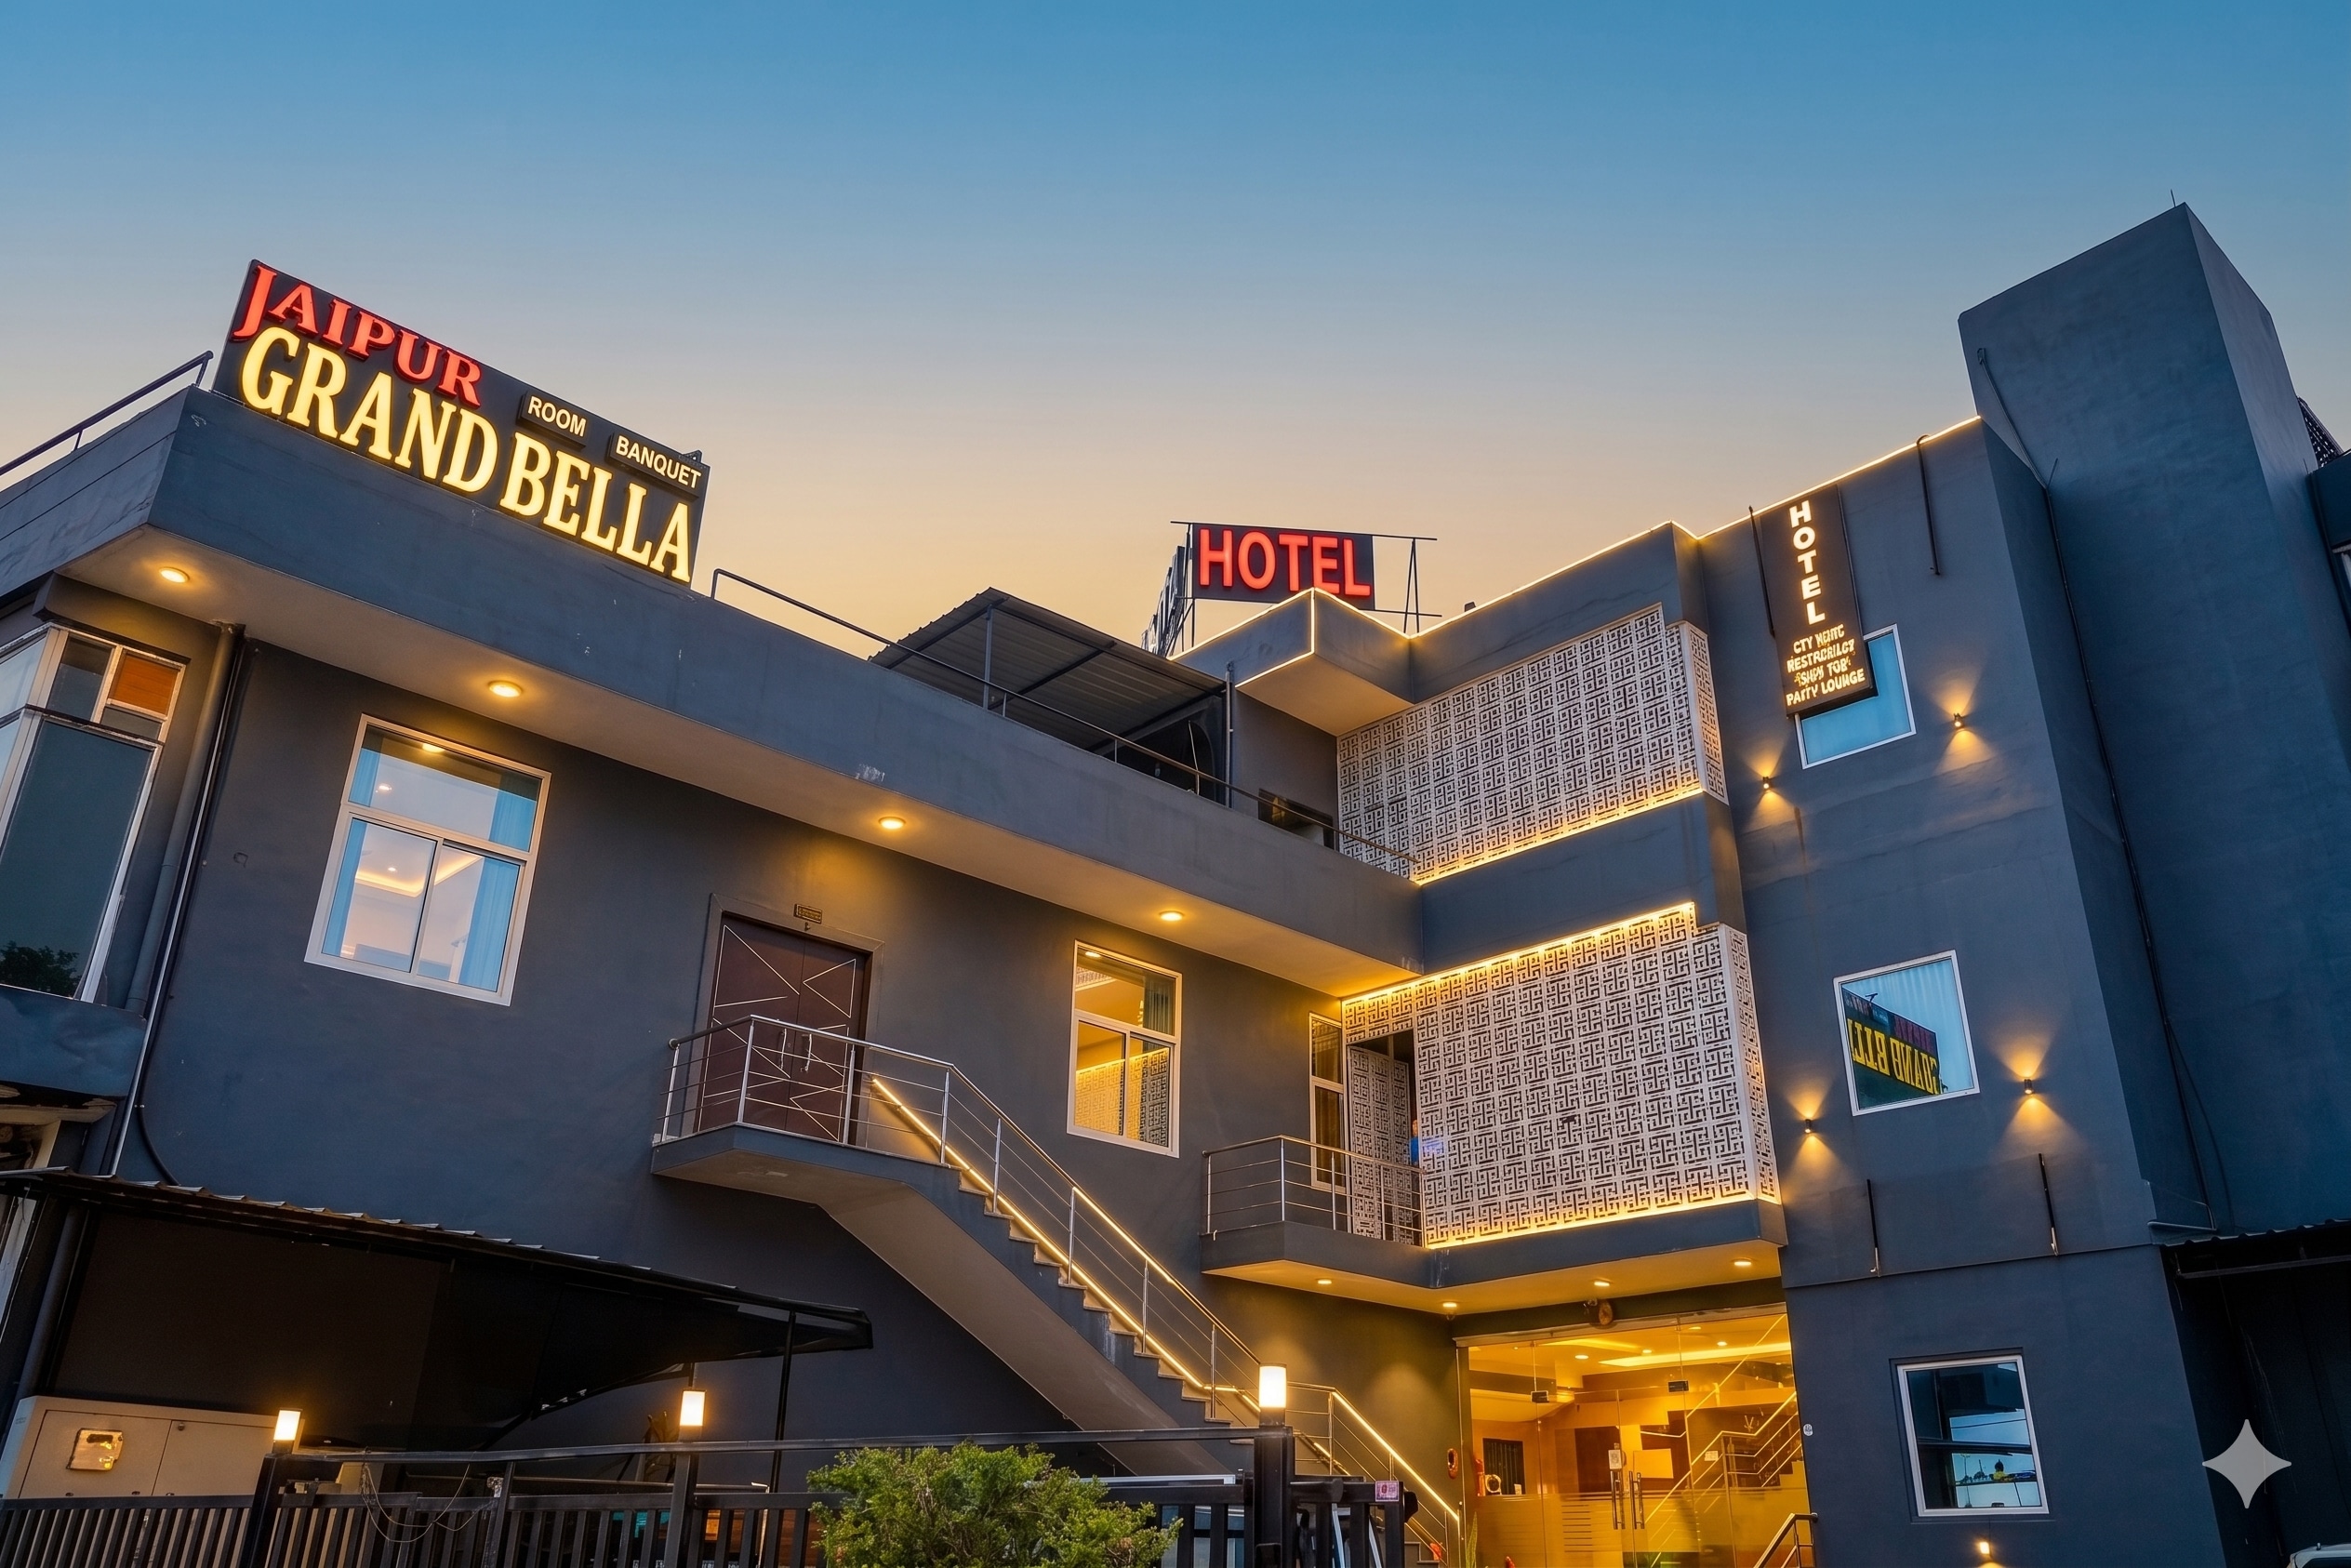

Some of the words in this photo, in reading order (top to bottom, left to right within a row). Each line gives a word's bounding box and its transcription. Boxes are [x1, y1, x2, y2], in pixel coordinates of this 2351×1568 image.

[232, 265, 481, 406] JAIPUR
[241, 326, 498, 493] GRAND
[499, 431, 693, 584] BELLA
[527, 394, 587, 438] ROOM
[616, 434, 702, 489] BANQUET
[1199, 528, 1371, 596] HOTEL
[1789, 500, 1826, 625] HOTEL
